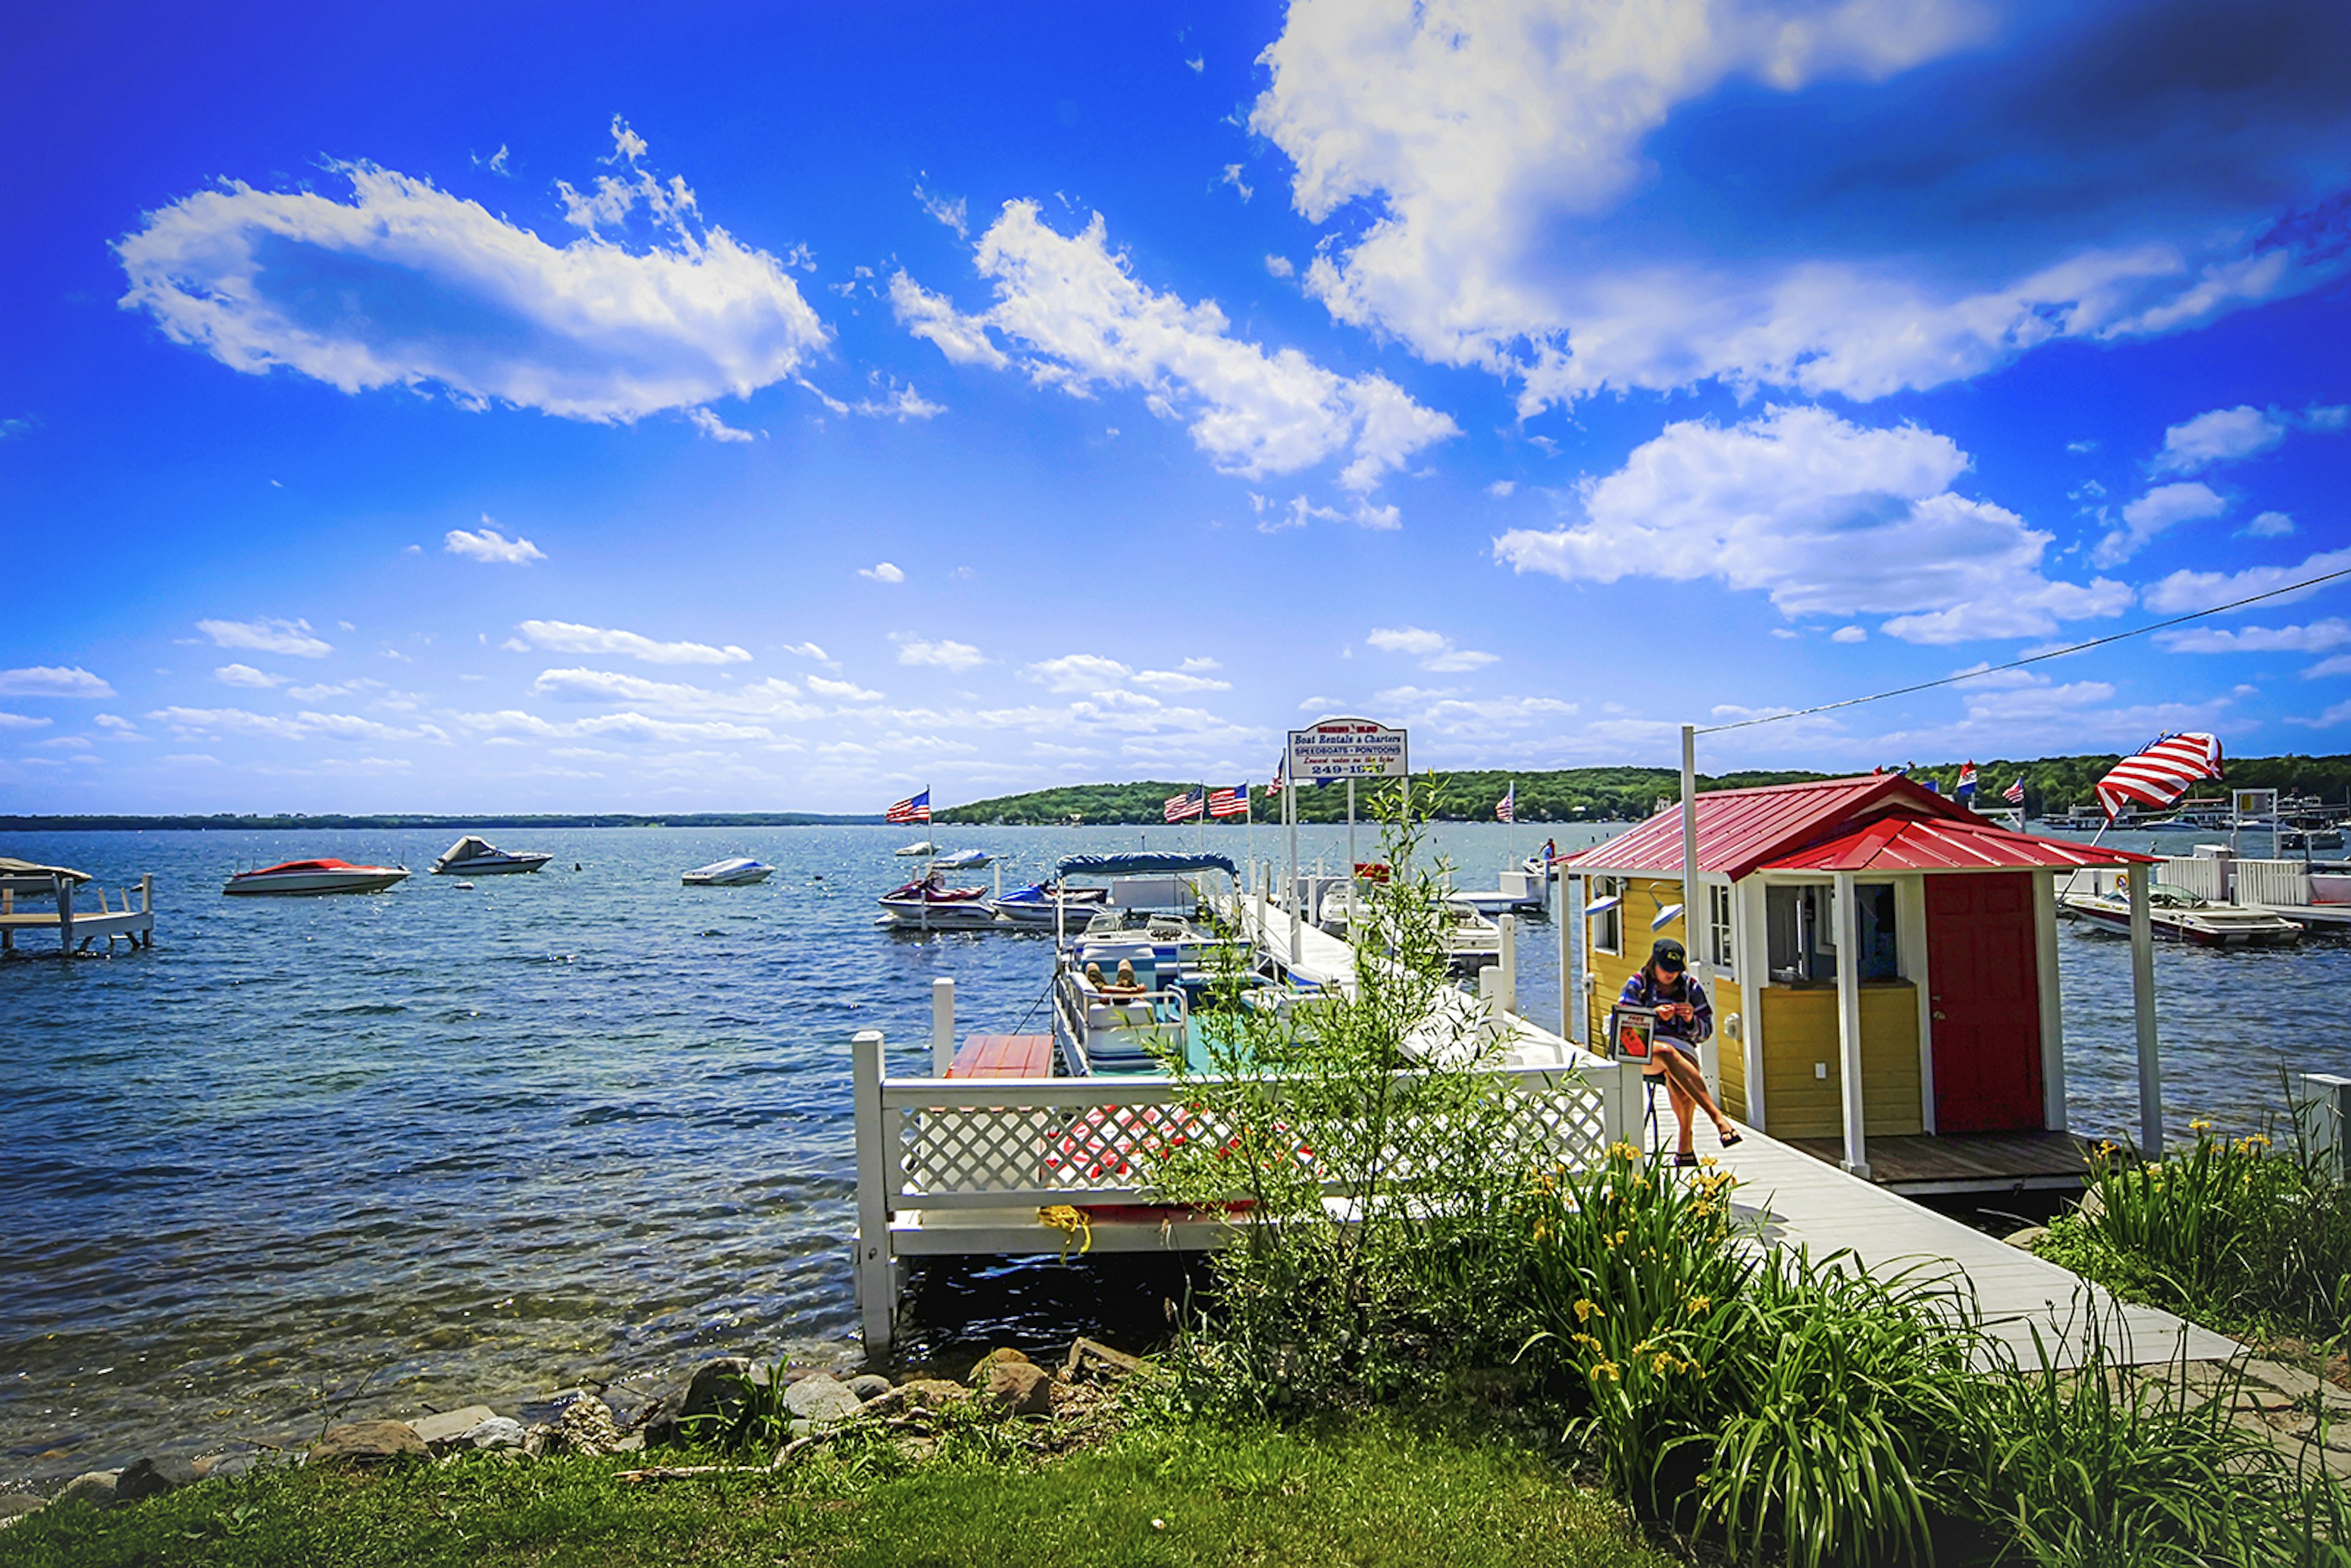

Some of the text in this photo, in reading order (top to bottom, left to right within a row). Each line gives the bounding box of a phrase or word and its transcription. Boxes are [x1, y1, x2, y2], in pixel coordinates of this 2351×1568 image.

[1295, 735, 1315, 744] Boat
[1320, 735, 1352, 744] Rentals
[1365, 735, 1400, 743] Charters
